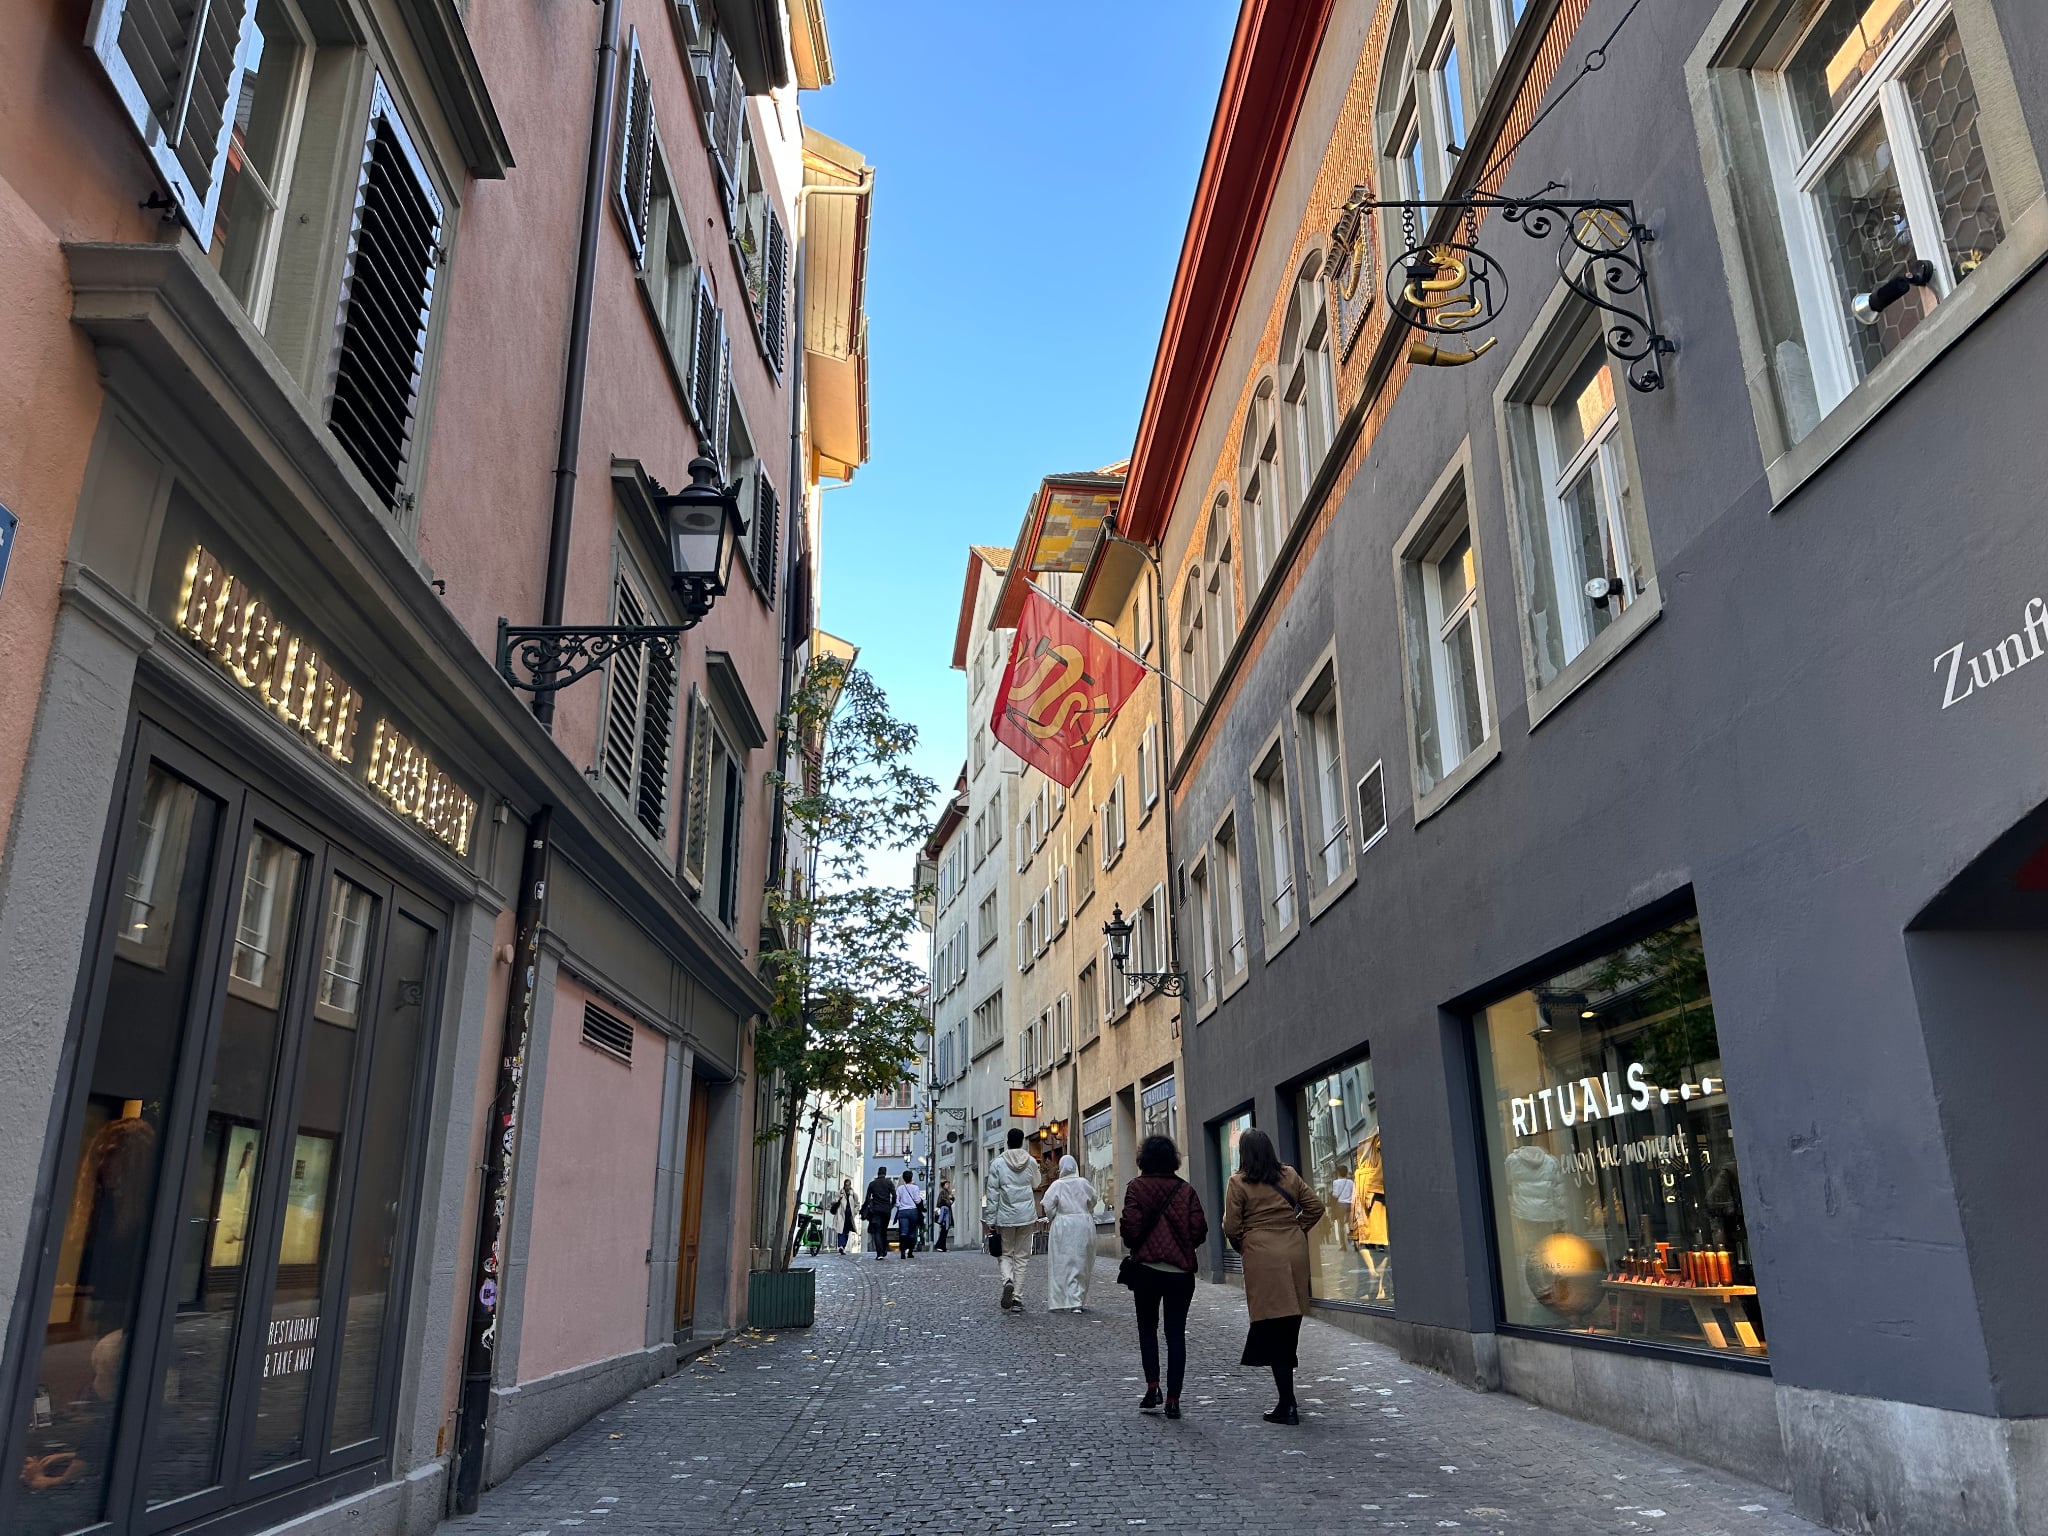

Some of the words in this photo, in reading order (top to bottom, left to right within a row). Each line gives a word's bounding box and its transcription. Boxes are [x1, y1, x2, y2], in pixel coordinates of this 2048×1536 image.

[180, 544, 363, 763] RACLETTE
[369, 718, 478, 856] FACTORY
[1596, 1136, 1621, 1169] the
[1623, 1124, 1689, 1165] moment
[267, 1316, 320, 1346] RESTAURANT
[263, 1353, 270, 1378] &
[272, 1350, 293, 1376] TAKE
[294, 1347, 315, 1372] AWAY
